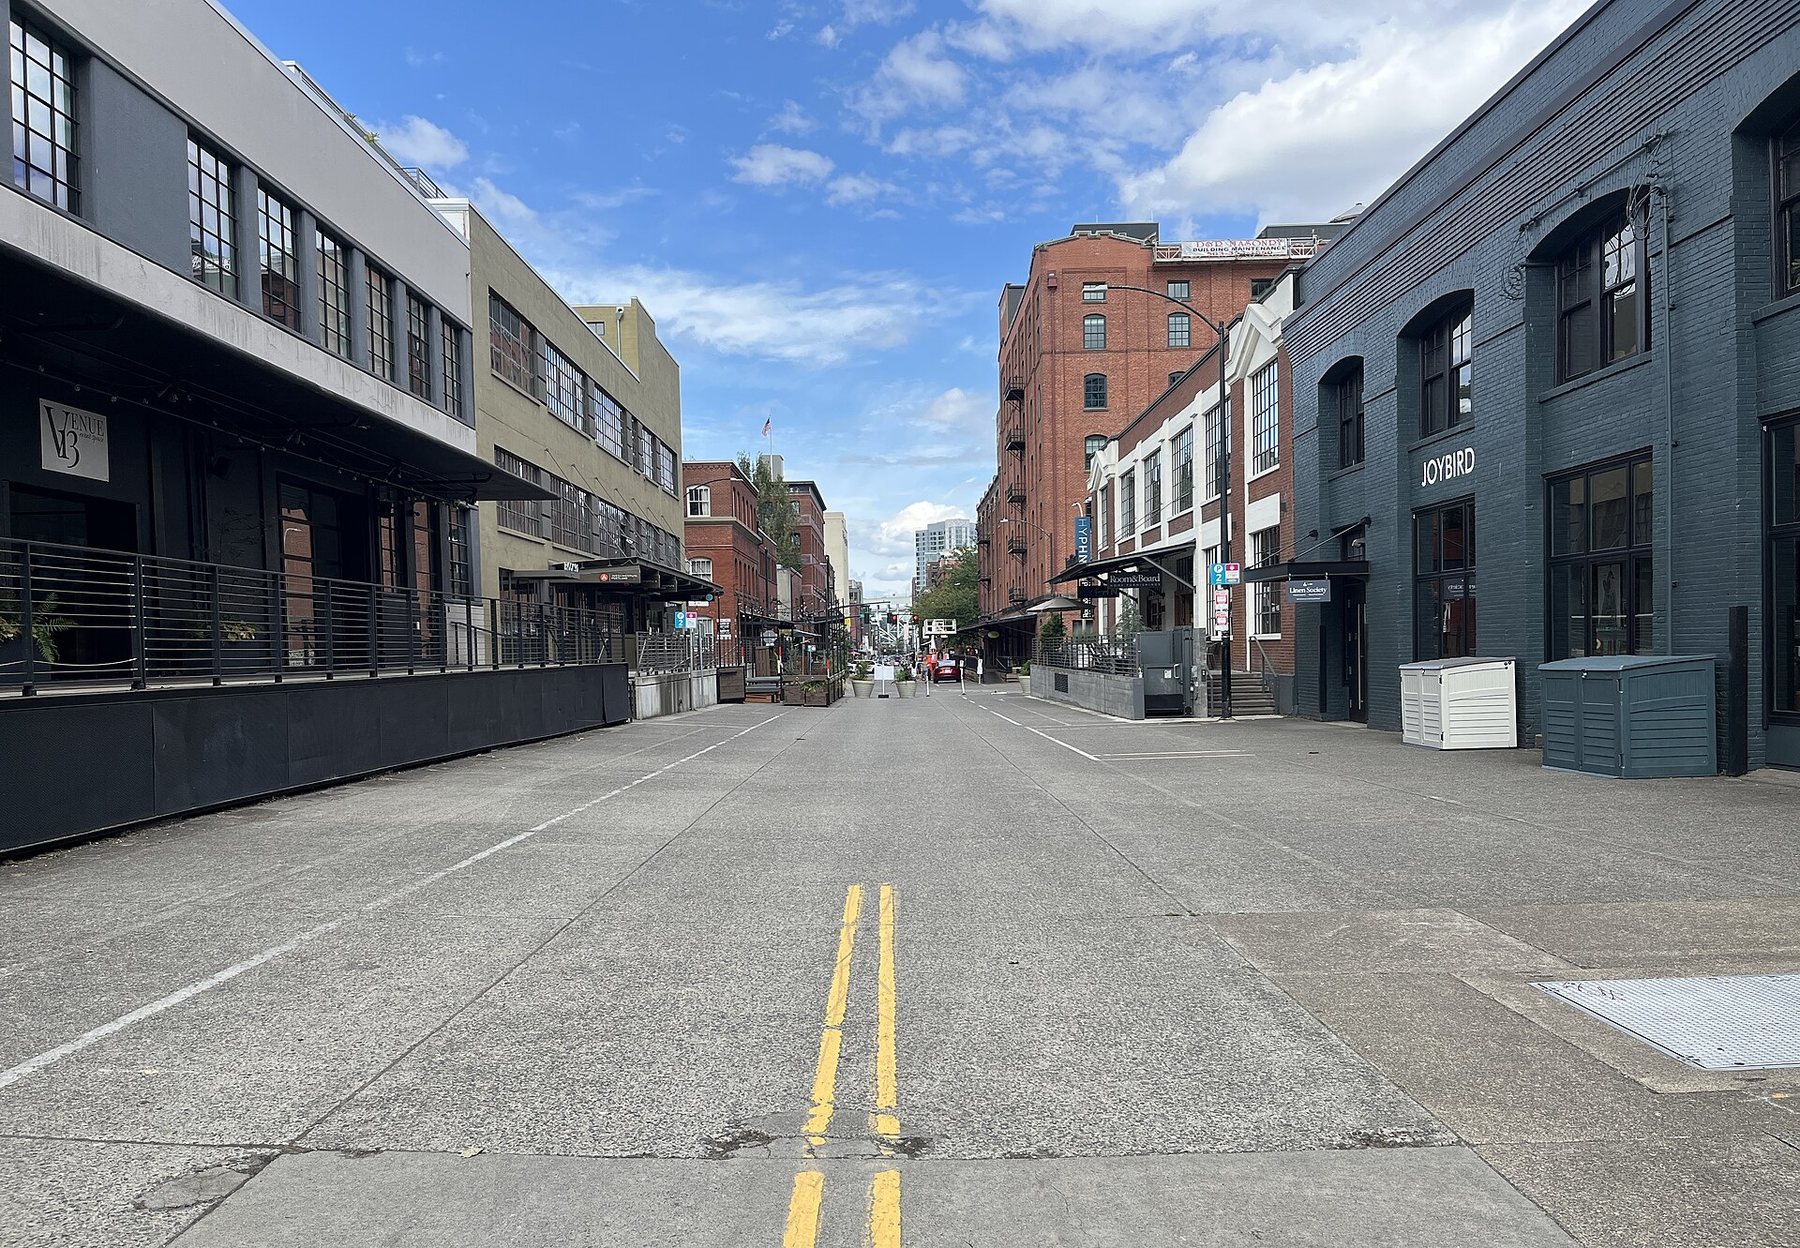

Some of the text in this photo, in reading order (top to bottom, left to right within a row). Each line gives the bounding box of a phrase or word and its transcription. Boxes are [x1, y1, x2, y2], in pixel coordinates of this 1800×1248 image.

[1421, 447, 1476, 487] JOYBIRD
[1110, 573, 1160, 583] Room&Board
[1215, 573, 1222, 582] 2
